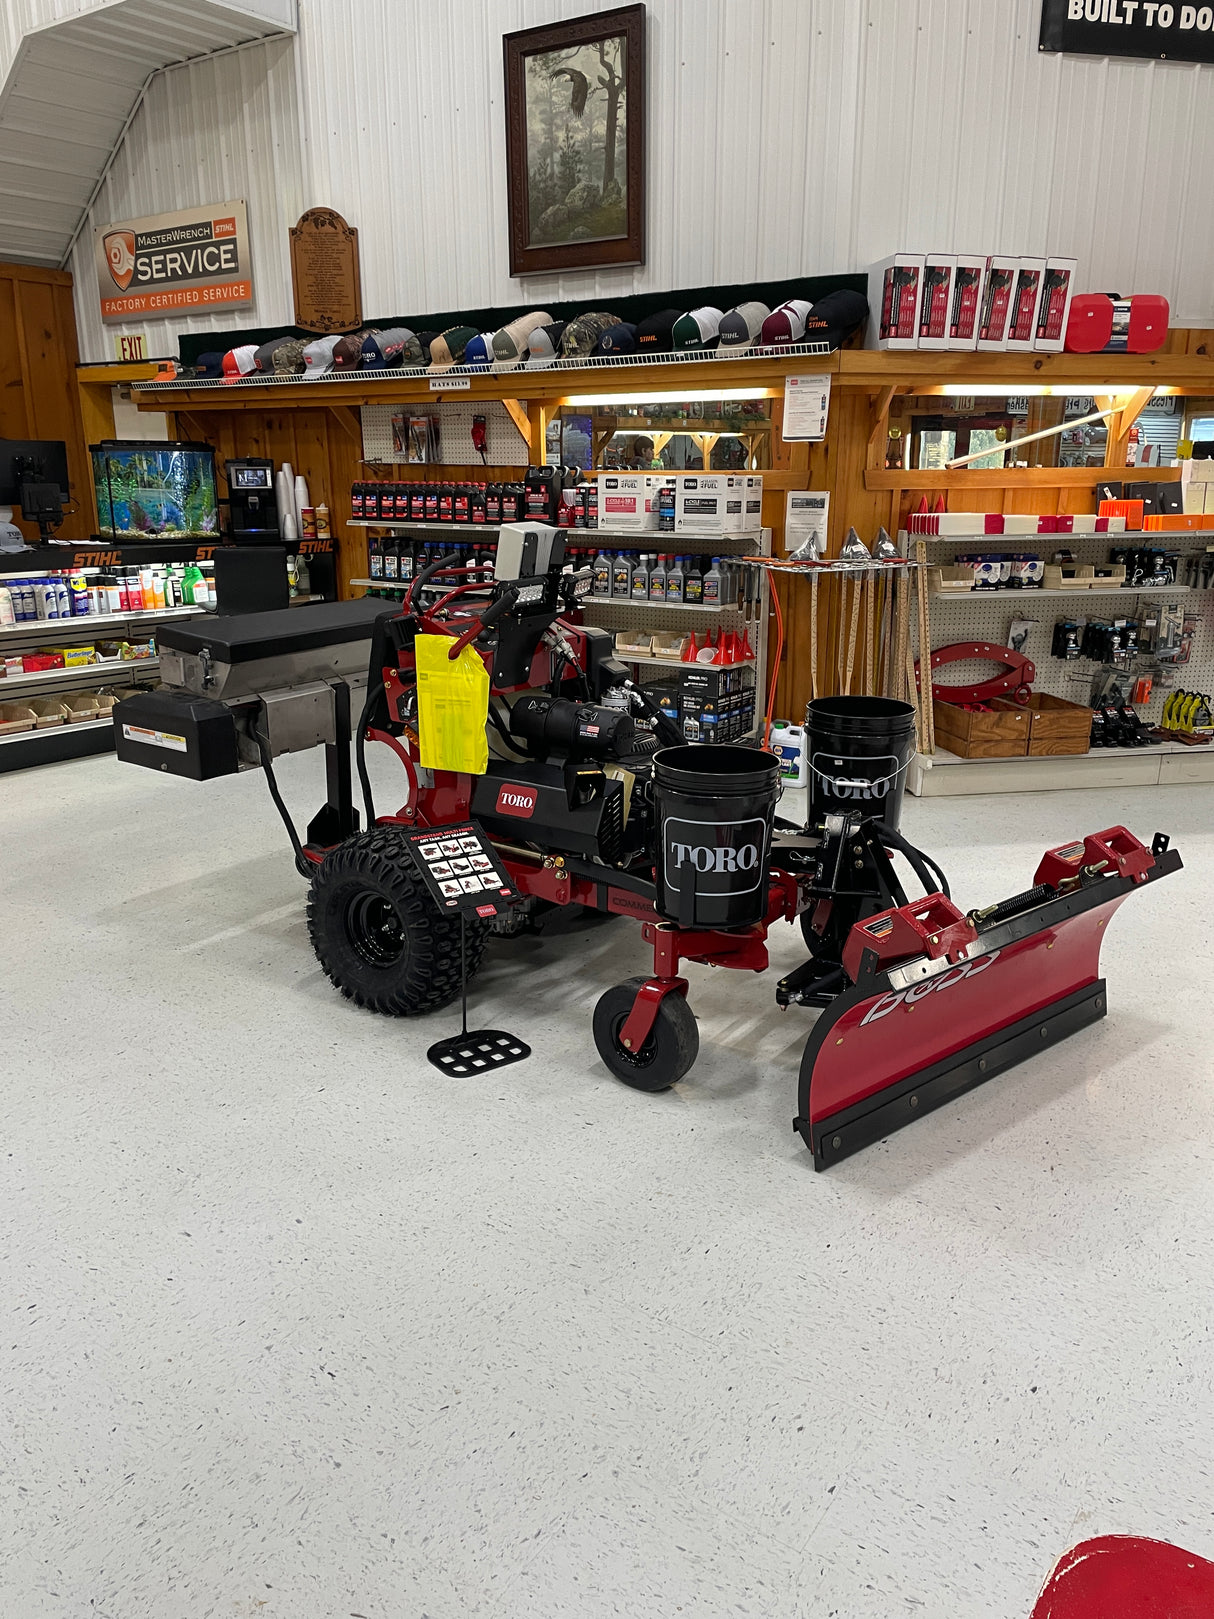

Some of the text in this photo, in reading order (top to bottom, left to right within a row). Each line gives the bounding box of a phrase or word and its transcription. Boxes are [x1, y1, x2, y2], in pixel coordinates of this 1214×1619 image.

[1067, 0, 1214, 32] BUILT TO DO
[215, 222, 234, 234] STIHL
[136, 243, 236, 281] SERVICE
[105, 284, 246, 312] FACTORY CERTIFIED SERVICE
[808, 320, 829, 329] STIHL
[640, 334, 657, 343] STIHL
[120, 336, 143, 361] EXIT
[298, 540, 334, 554] STIHL
[73, 551, 122, 567] STIHL
[822, 774, 890, 800] TORO
[501, 791, 534, 809] TORO
[671, 842, 758, 873] TORO
[613, 897, 654, 912] COMME
